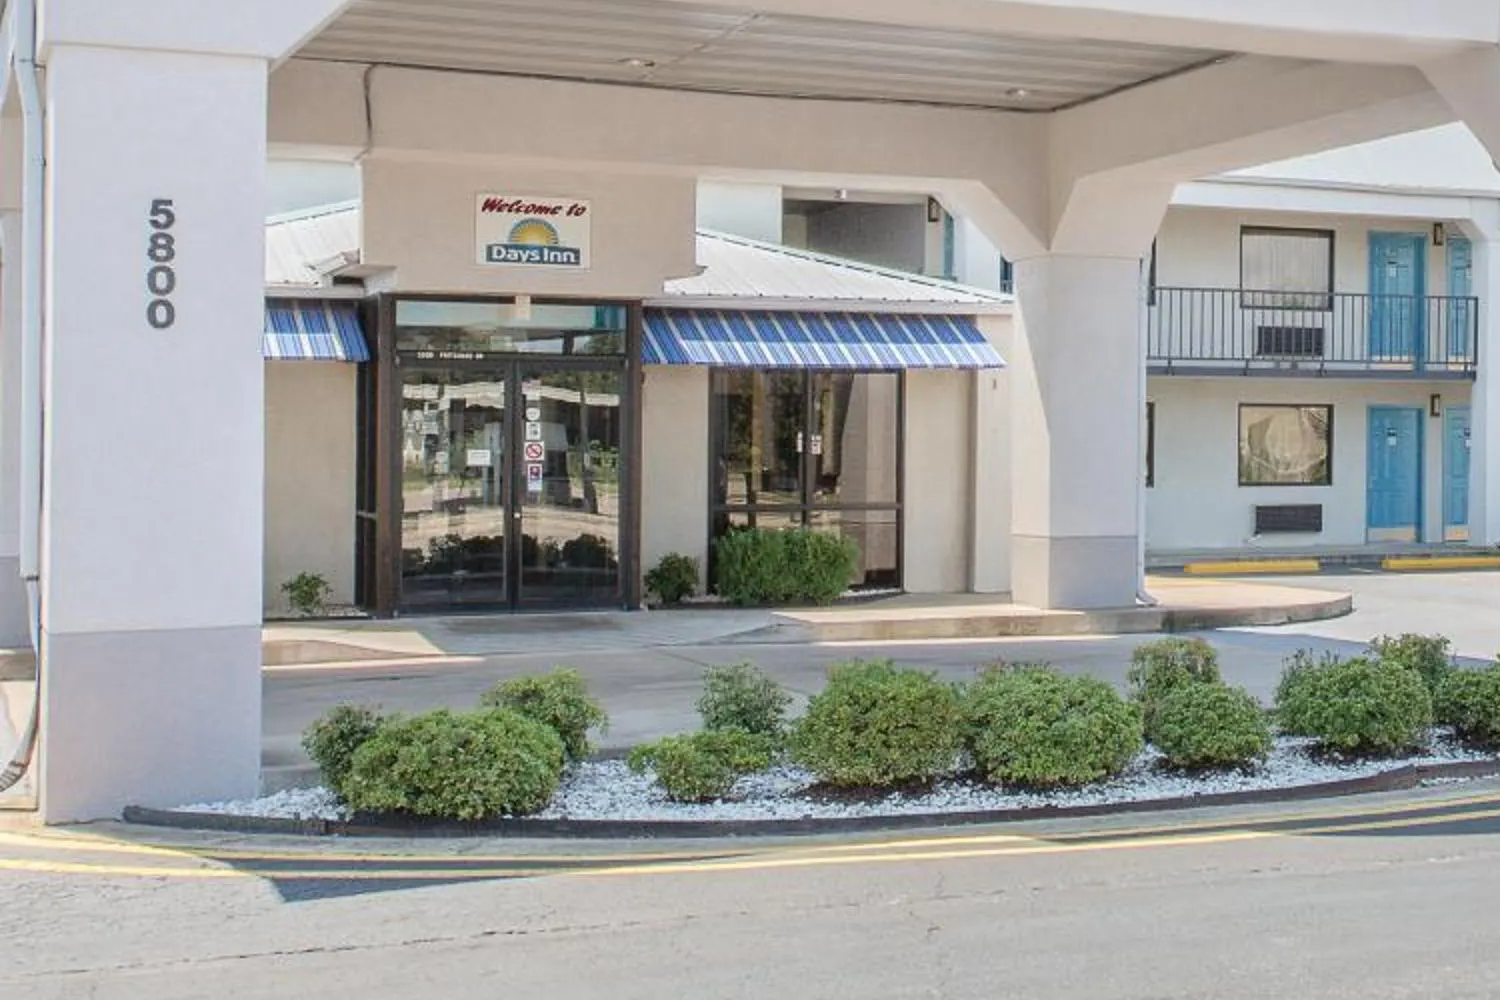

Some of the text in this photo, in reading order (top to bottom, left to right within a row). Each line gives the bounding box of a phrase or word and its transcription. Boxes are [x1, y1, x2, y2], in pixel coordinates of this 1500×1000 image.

[481, 197, 587, 217] Welcome to
[147, 199, 175, 329] 5800
[491, 245, 576, 263] Days Inn
